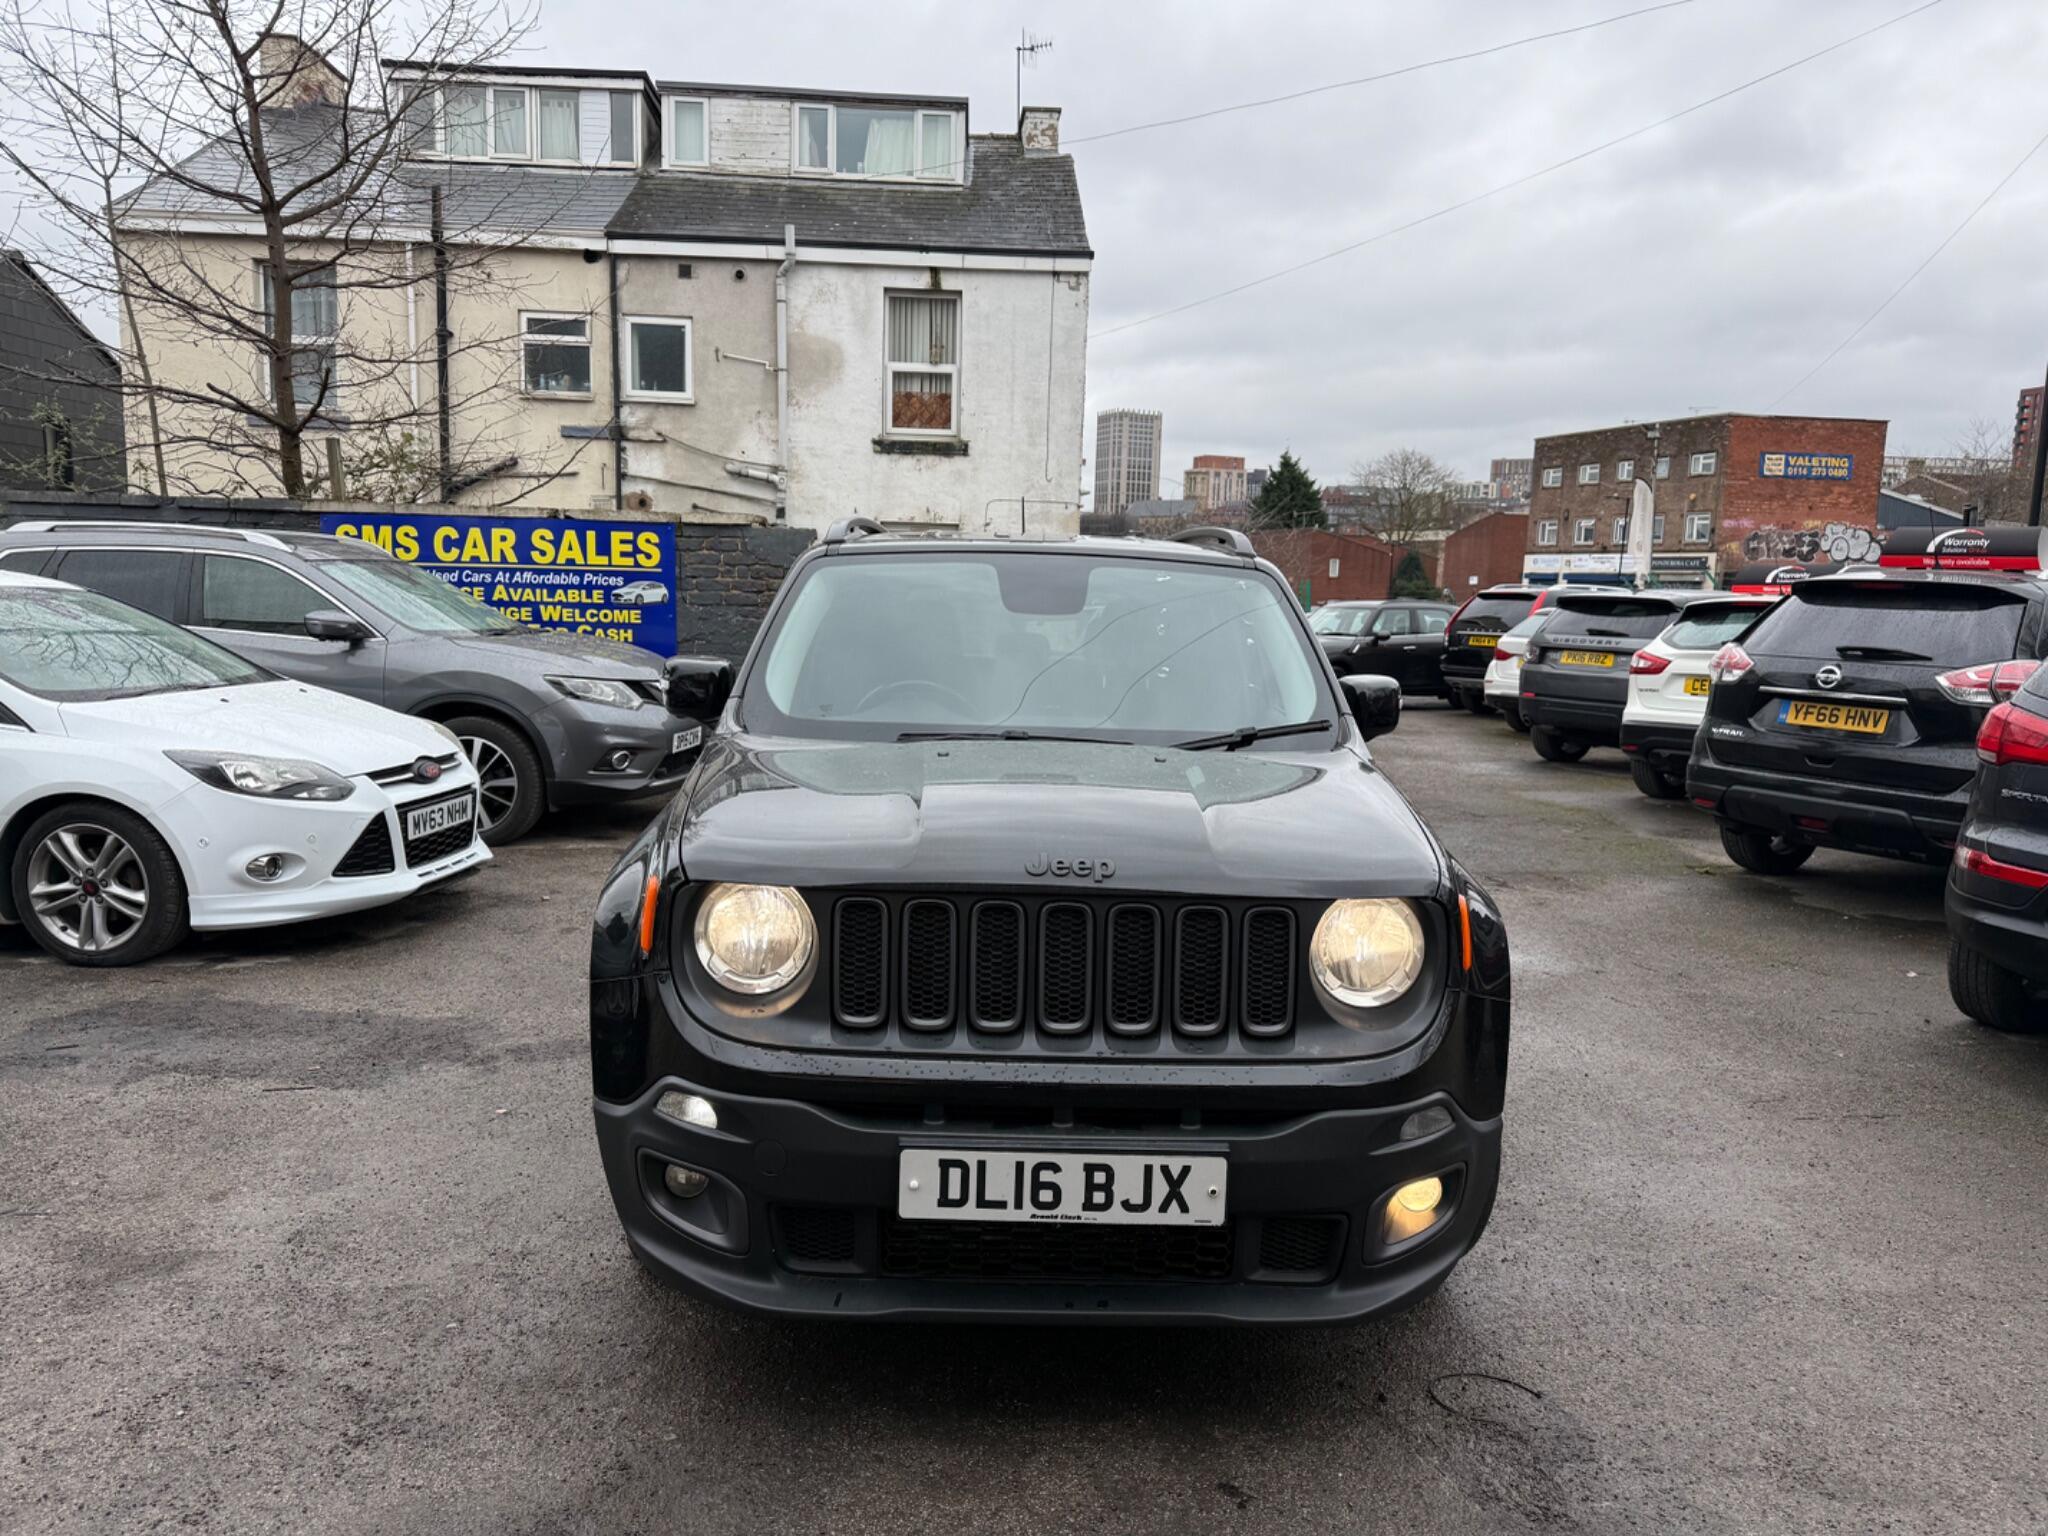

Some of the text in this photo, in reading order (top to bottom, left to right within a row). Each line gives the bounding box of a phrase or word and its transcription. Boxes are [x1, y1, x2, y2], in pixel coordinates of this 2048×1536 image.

[1788, 455, 1849, 467] VALETING
[433, 525, 518, 563] CAR
[530, 527, 661, 567] SALES
[1944, 537, 1990, 549] Warranty
[462, 569, 492, 583] Cars
[494, 570, 511, 583] At
[512, 571, 580, 585] Affordable
[583, 573, 625, 587] Prices
[492, 584, 605, 604] AVAILABLE
[539, 604, 642, 624] WELCOME
[1552, 637, 1622, 646] DISCOVERY
[1793, 703, 1884, 729] YF66 HNV
[412, 807, 445, 836] MV63
[1024, 852, 1116, 883] Jeep
[937, 1158, 1192, 1214] DL16 BJX
